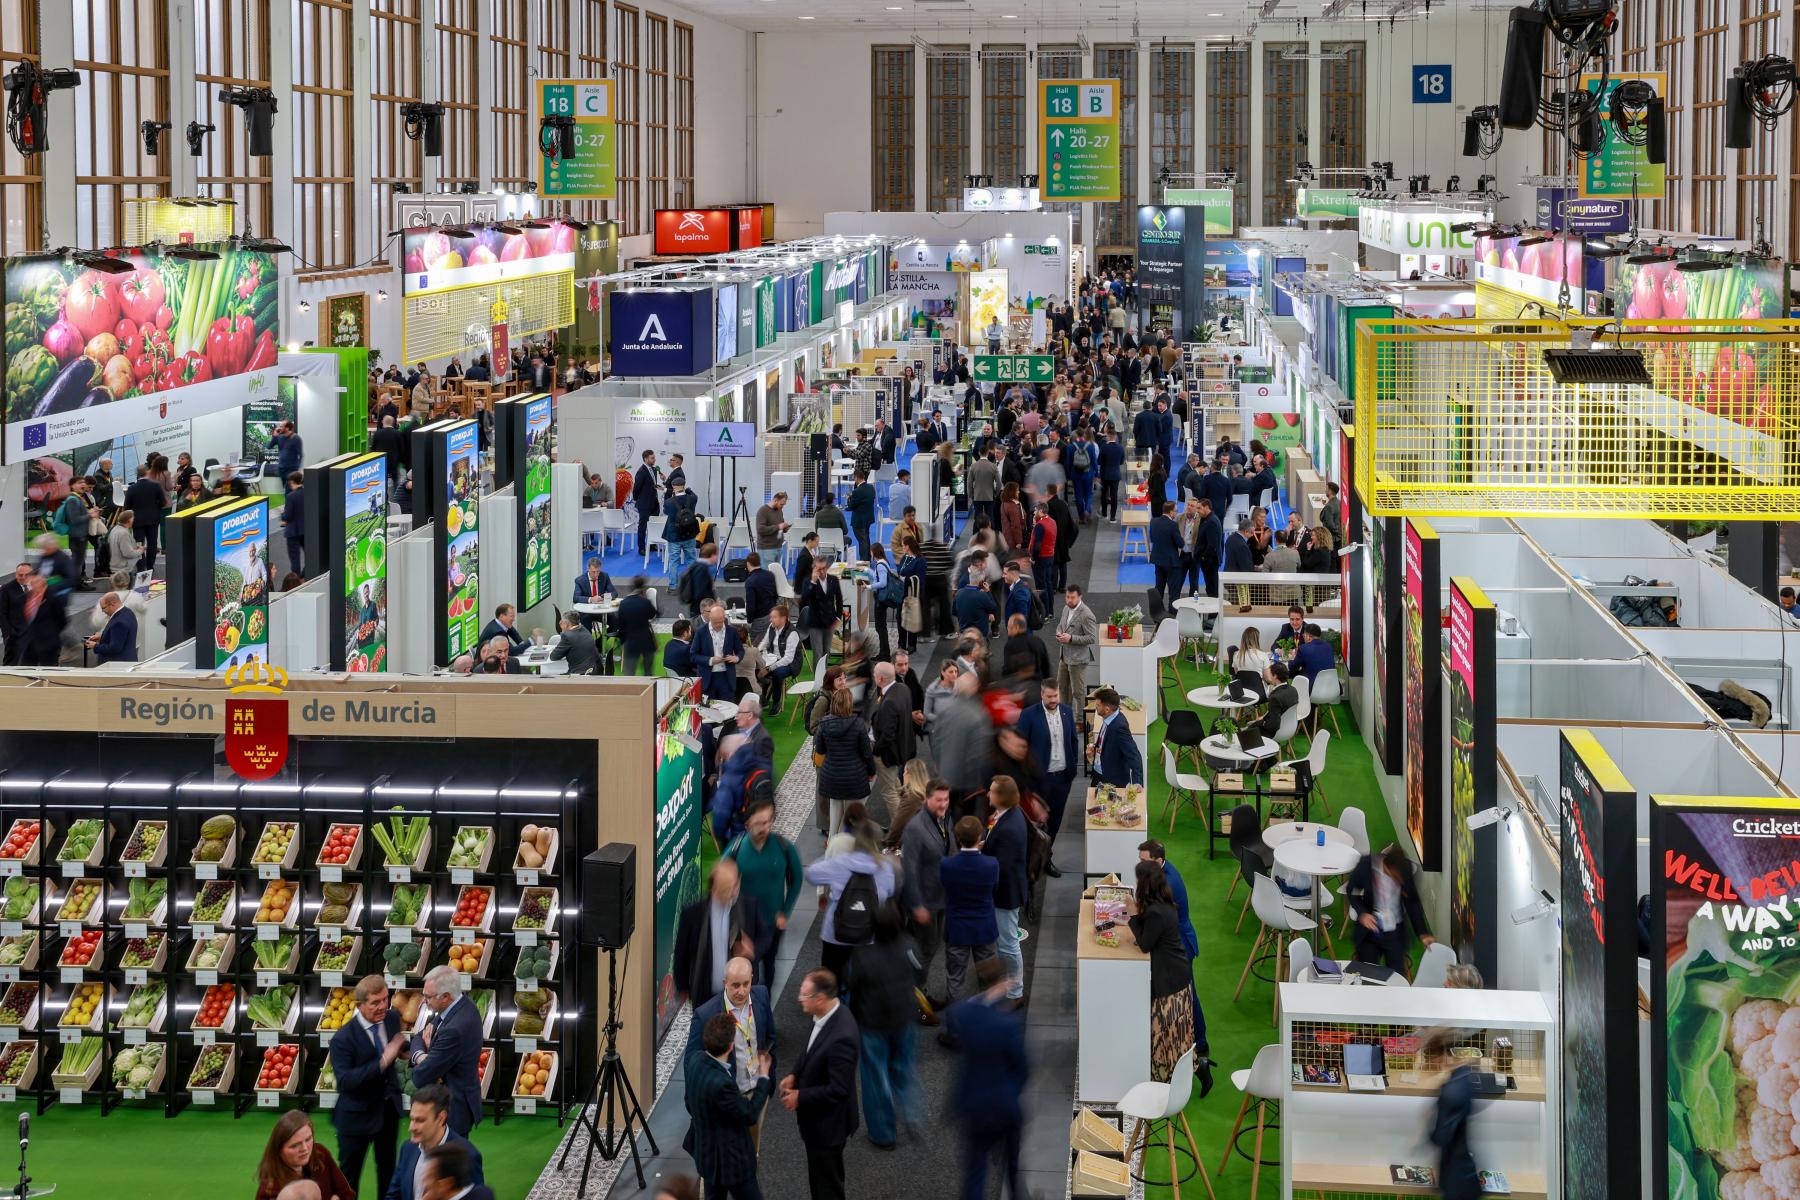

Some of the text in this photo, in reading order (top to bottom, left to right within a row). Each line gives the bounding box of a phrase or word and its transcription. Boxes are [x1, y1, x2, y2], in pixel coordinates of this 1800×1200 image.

[1418, 74, 1444, 94] 18
[548, 98, 568, 112] 18
[586, 96, 598, 112] C
[1052, 98, 1072, 113] 18
[1090, 96, 1102, 112] B
[574, 134, 606, 147] 0-27
[1070, 136, 1110, 148] 20-27
[1566, 204, 1618, 216] anynature
[674, 233, 709, 242] lapalma
[1142, 230, 1180, 240] CENTRO SUR
[49, 418, 85, 430] Financiado por
[54, 431, 69, 440] Unión
[71, 426, 90, 438] Europea
[352, 462, 380, 484] proexport
[223, 508, 260, 534] proexport
[120, 697, 436, 726] Región de Murcia
[1571, 818, 1595, 904] FUTURE
[668, 852, 684, 888] SPAIN
[1696, 894, 1793, 934] A WAY
[1592, 906, 1604, 944] ALL
[1742, 936, 1796, 950] AND TO
